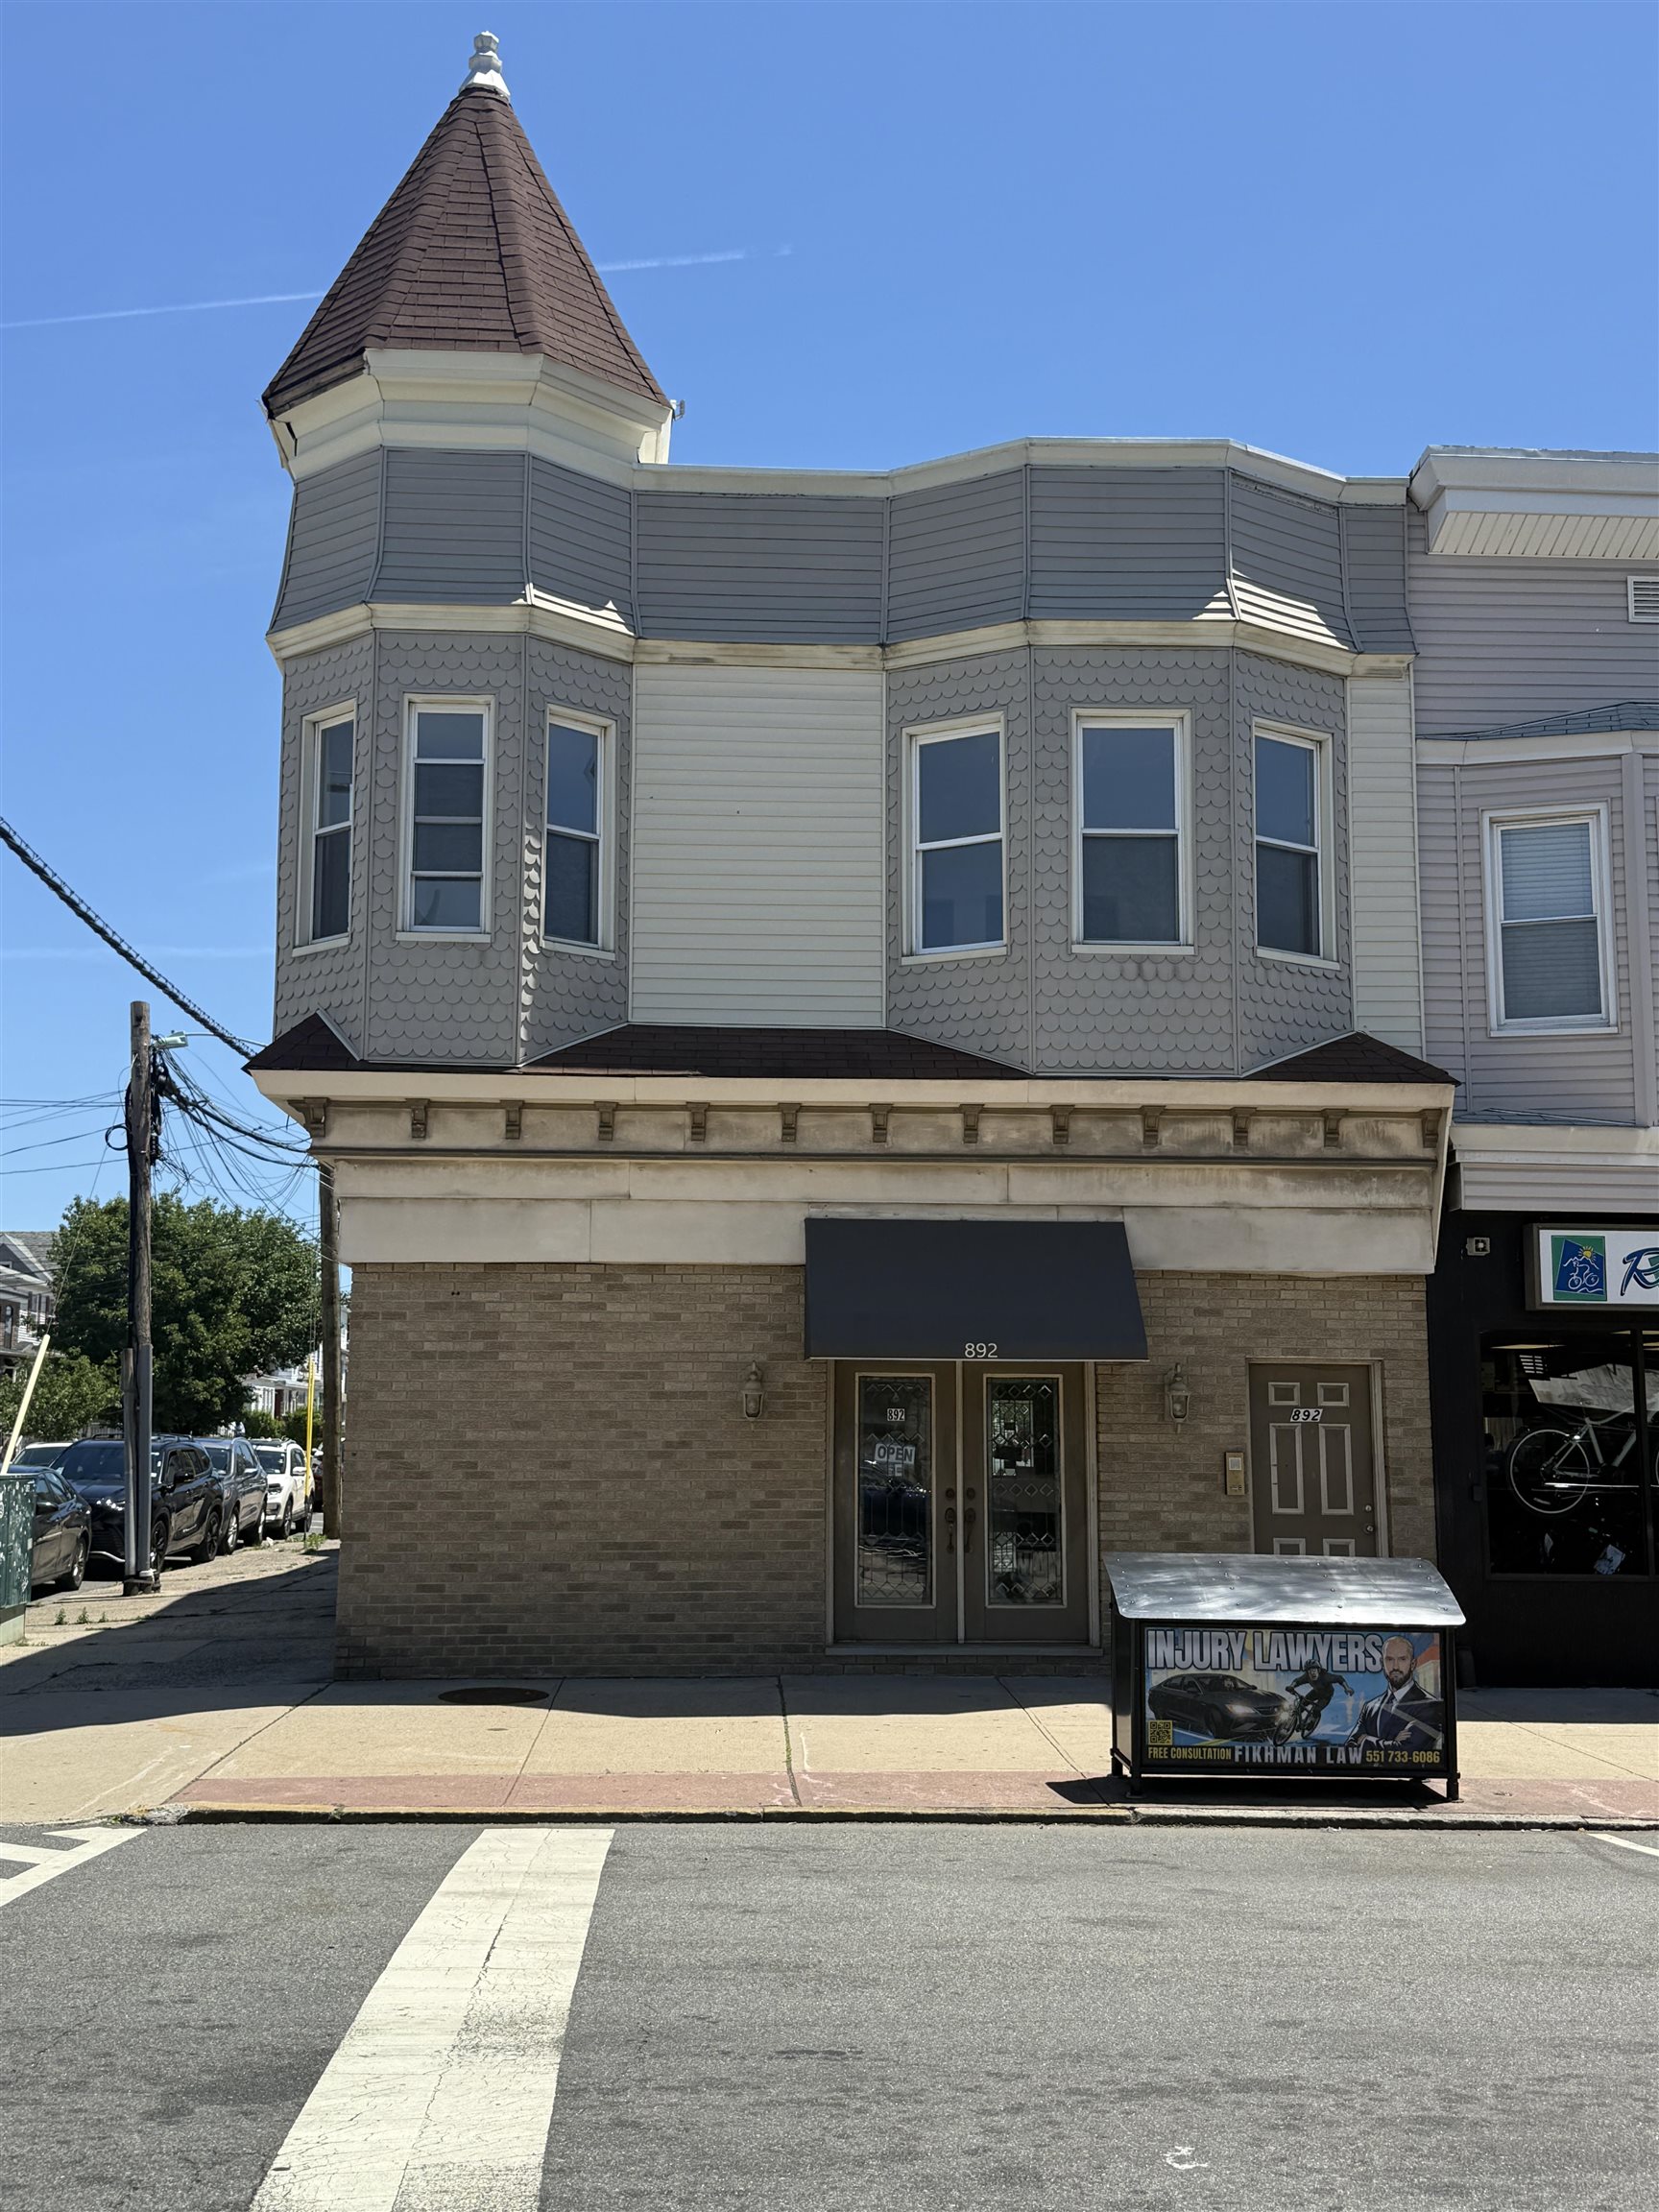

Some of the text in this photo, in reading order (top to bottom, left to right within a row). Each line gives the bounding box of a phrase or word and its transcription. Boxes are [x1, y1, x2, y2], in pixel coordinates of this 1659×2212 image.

[965, 1343, 998, 1358] 892
[888, 1409, 904, 1421] 892
[1291, 1409, 1321, 1421] 892
[878, 1445, 913, 1462] OPEN
[1147, 1629, 1383, 1672] INJURY LAWYERS
[1148, 1747, 1232, 1760] FREE CONSULTATION
[1234, 1745, 1362, 1765] FIKHMAN LAW
[1365, 1750, 1440, 1764] 551 733-6086
